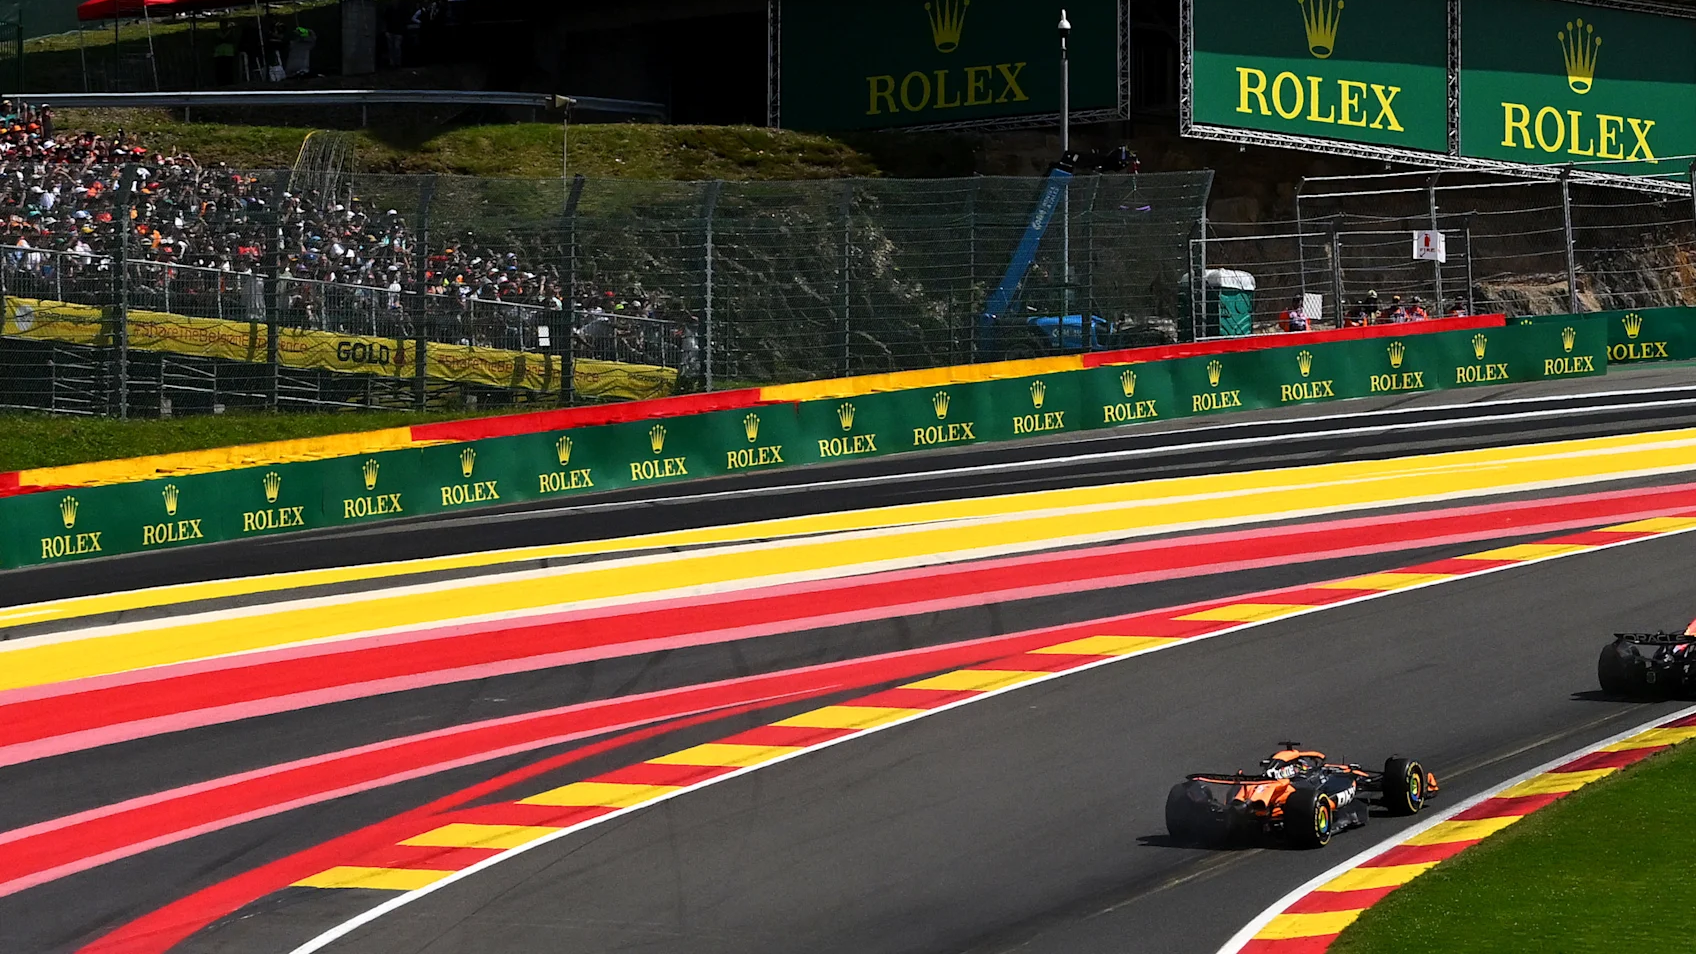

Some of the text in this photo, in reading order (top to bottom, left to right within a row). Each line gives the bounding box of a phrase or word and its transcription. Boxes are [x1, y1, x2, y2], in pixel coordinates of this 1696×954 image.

[866, 61, 1029, 115] ROLEX
[1235, 66, 1405, 133] ROLEX
[1500, 101, 1659, 164] ROLEX
[337, 341, 390, 365] GOLD
[1607, 342, 1668, 360] ROLEX
[1456, 363, 1508, 383] ROLEX
[1544, 356, 1594, 375] ROLEX
[1281, 380, 1334, 401] ROLEX
[1370, 372, 1424, 392] ROLEX
[1103, 400, 1158, 422] ROLEX
[1192, 390, 1242, 412] ROLEX
[913, 422, 975, 445] ROLEX
[1013, 411, 1064, 434] ROLEX
[818, 434, 877, 457] ROLEX
[630, 457, 688, 481] ROLEX
[727, 446, 784, 469] ROLEX
[539, 469, 594, 493] ROLEX
[441, 481, 500, 506] ROLEX
[343, 493, 403, 518] ROLEX
[243, 506, 304, 531] ROLEX
[143, 519, 203, 545] ROLEX
[41, 532, 102, 558] ROLEX
